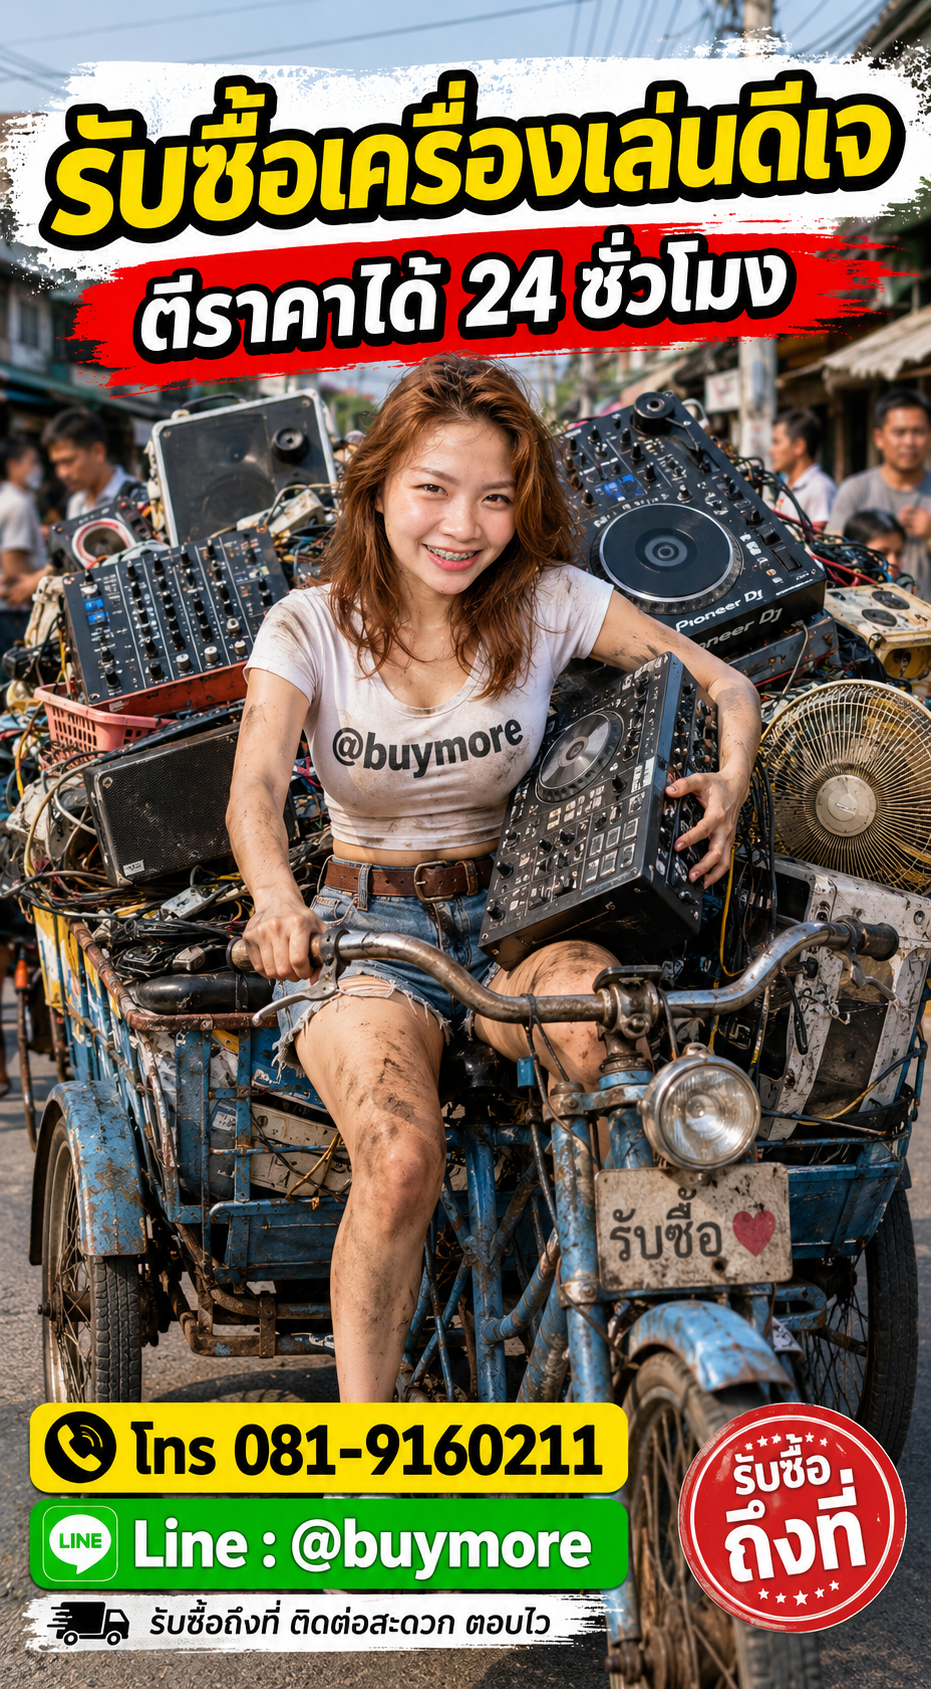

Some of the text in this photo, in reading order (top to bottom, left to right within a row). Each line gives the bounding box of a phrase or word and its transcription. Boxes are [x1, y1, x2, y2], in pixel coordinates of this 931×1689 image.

[675, 599, 741, 633] Pioneer
[332, 719, 524, 778] @buymore
[609, 1186, 723, 1262] รับซื้อ
